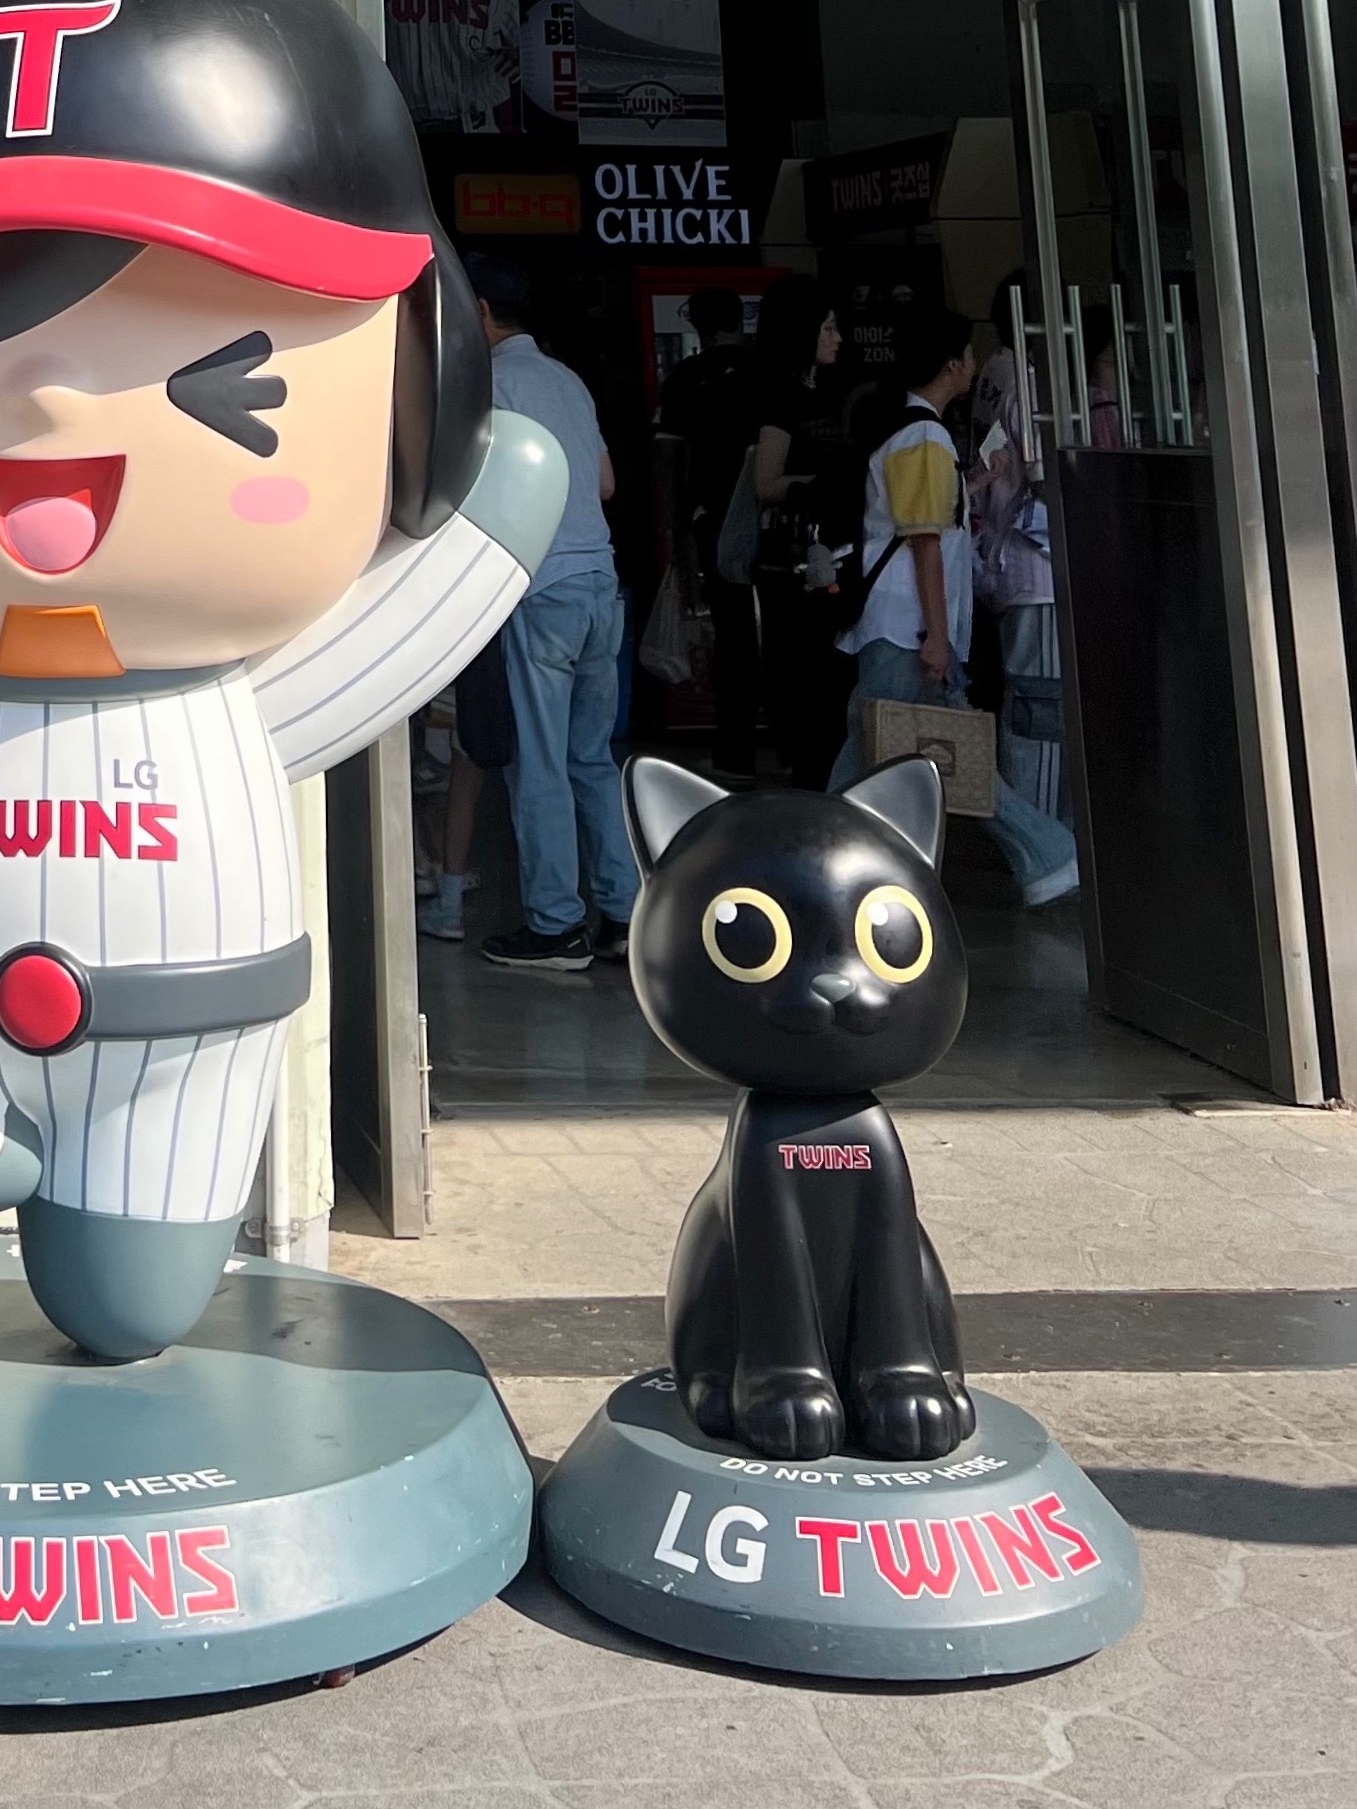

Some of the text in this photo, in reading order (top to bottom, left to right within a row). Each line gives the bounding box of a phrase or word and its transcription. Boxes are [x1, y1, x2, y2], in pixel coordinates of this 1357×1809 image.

[594, 157, 733, 202] OLIVE
[113, 758, 159, 790] LG
[778, 1144, 872, 1170] TWINS
[103, 1468, 238, 1498] HERE
[719, 1454, 1009, 1489] DO NOT STEP HERE
[654, 1490, 1102, 1600] LG TWINS
